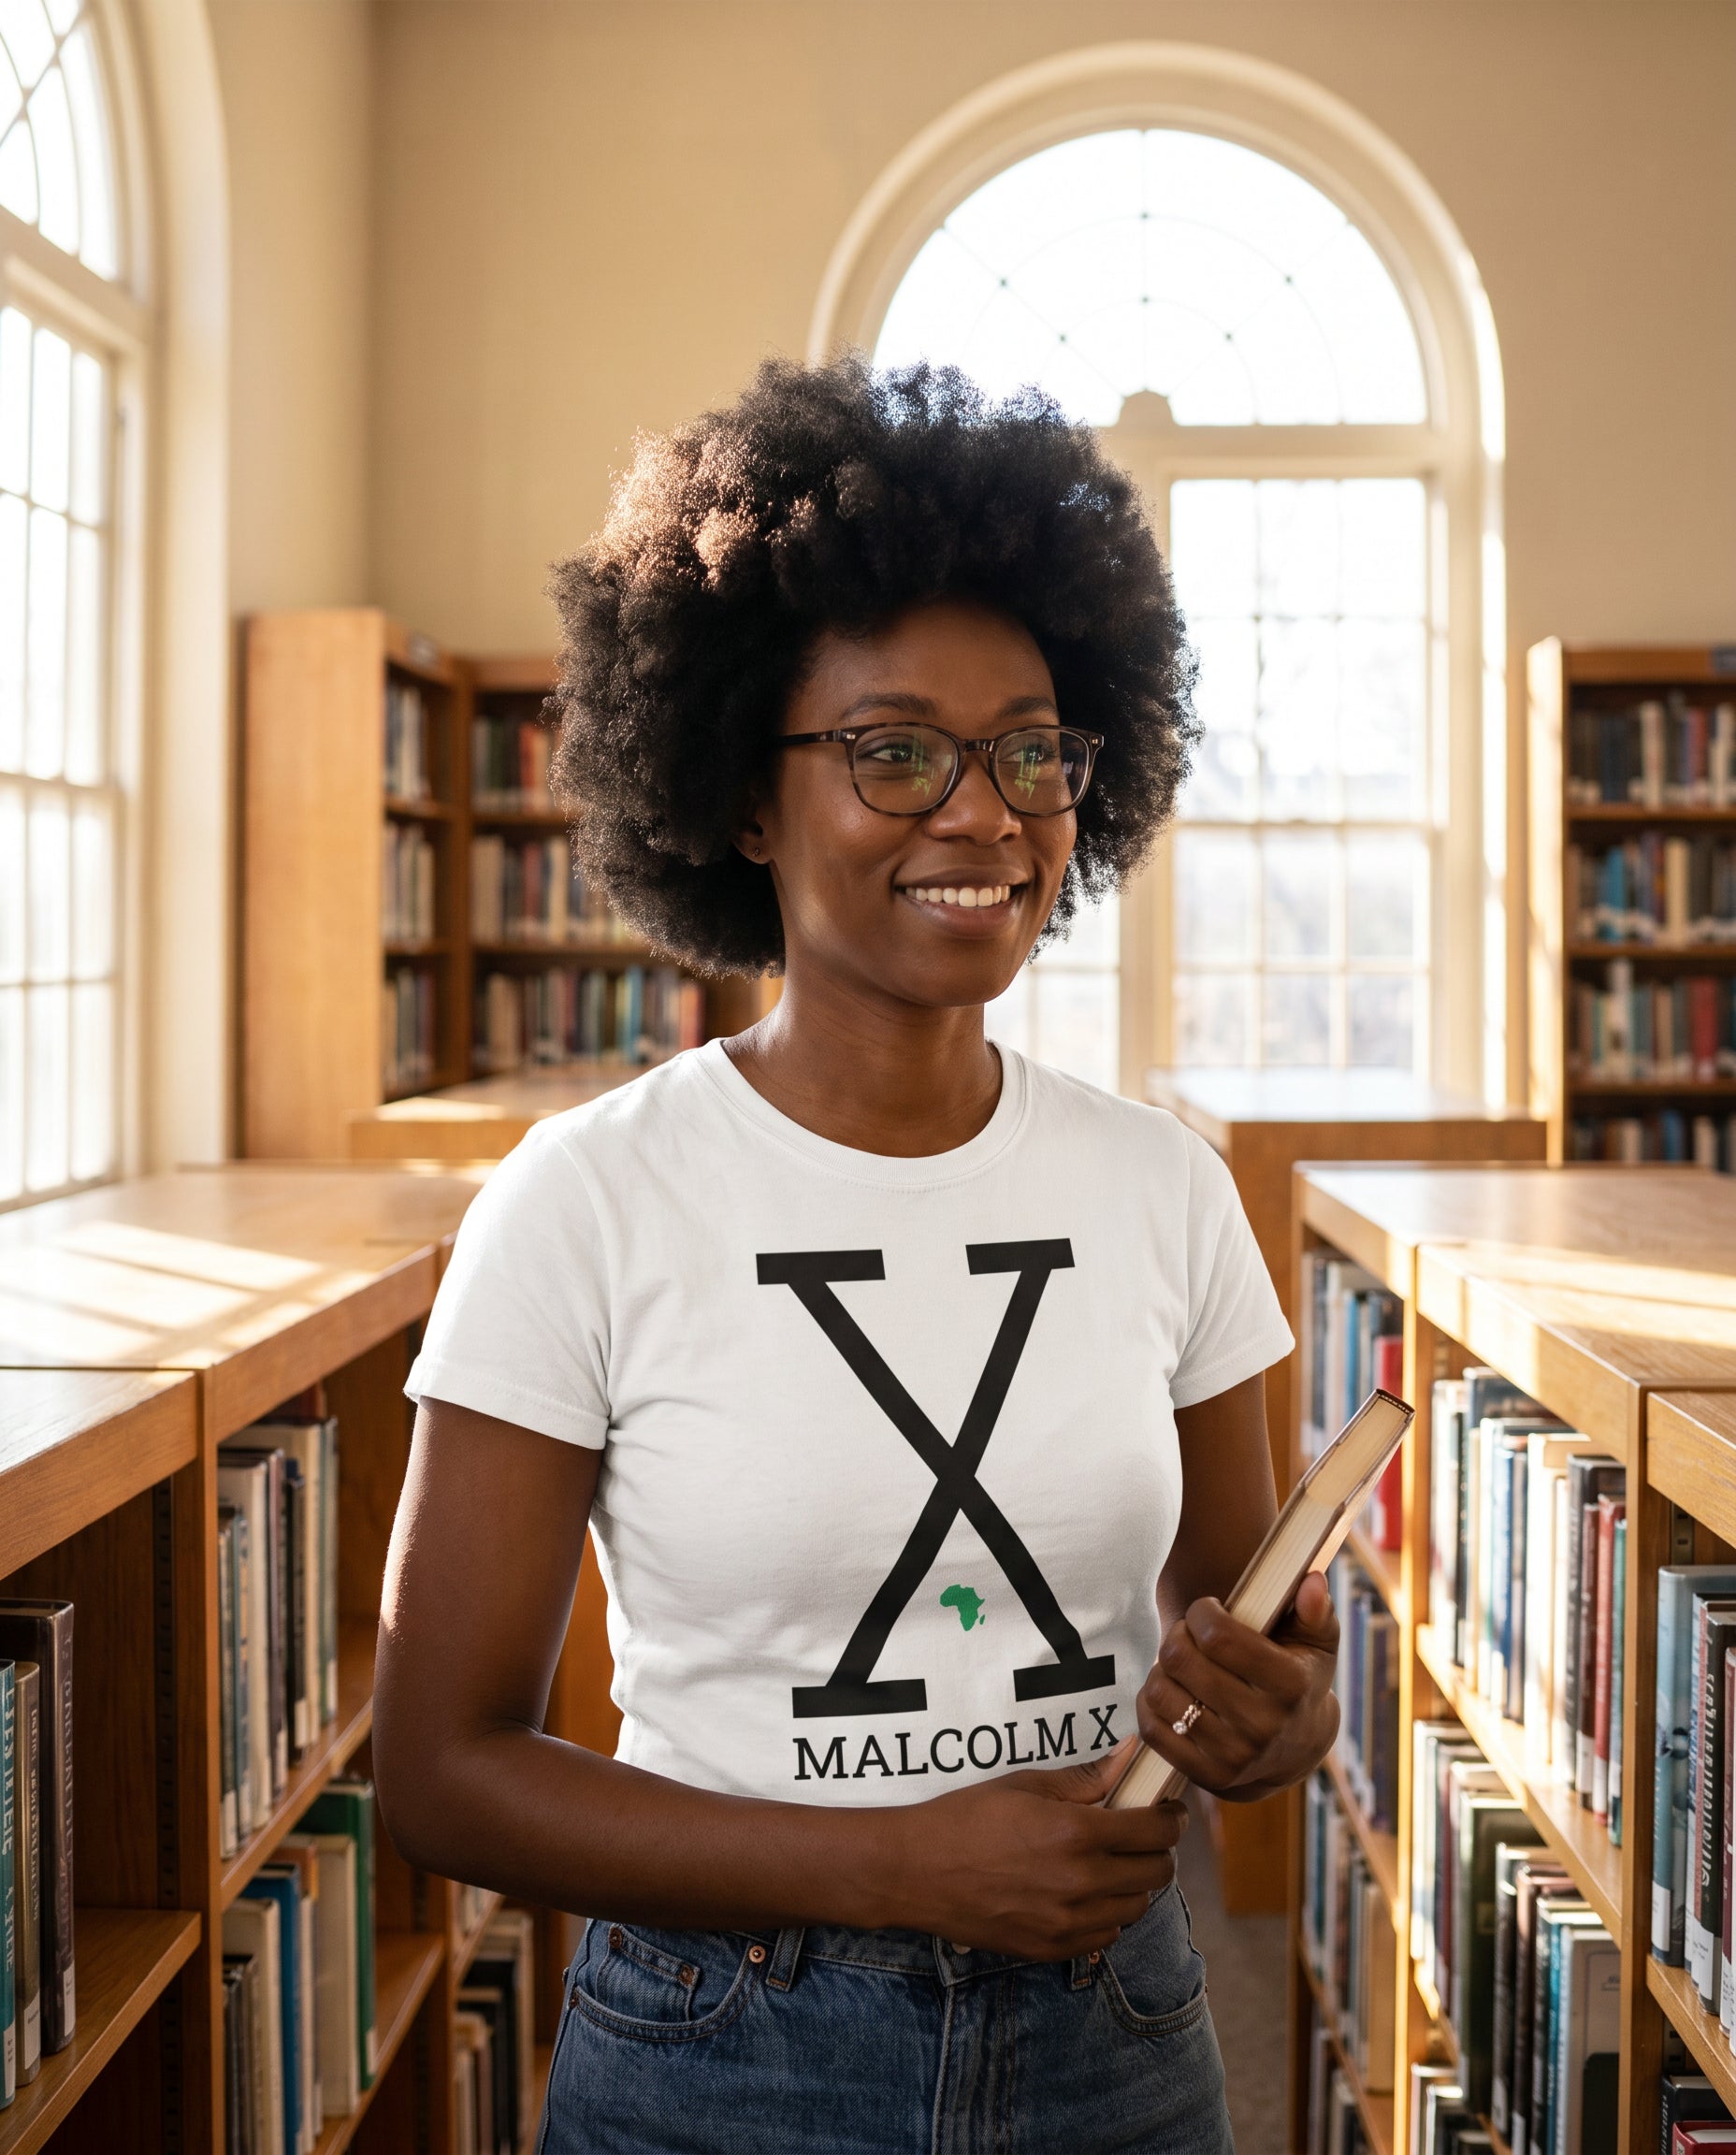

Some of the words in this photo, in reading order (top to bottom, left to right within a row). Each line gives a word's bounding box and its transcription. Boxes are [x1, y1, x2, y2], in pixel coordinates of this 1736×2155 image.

[756, 1237, 1117, 1719] X
[792, 1712, 1078, 1781] MALCOLM
[1088, 1703, 1121, 1752] X
